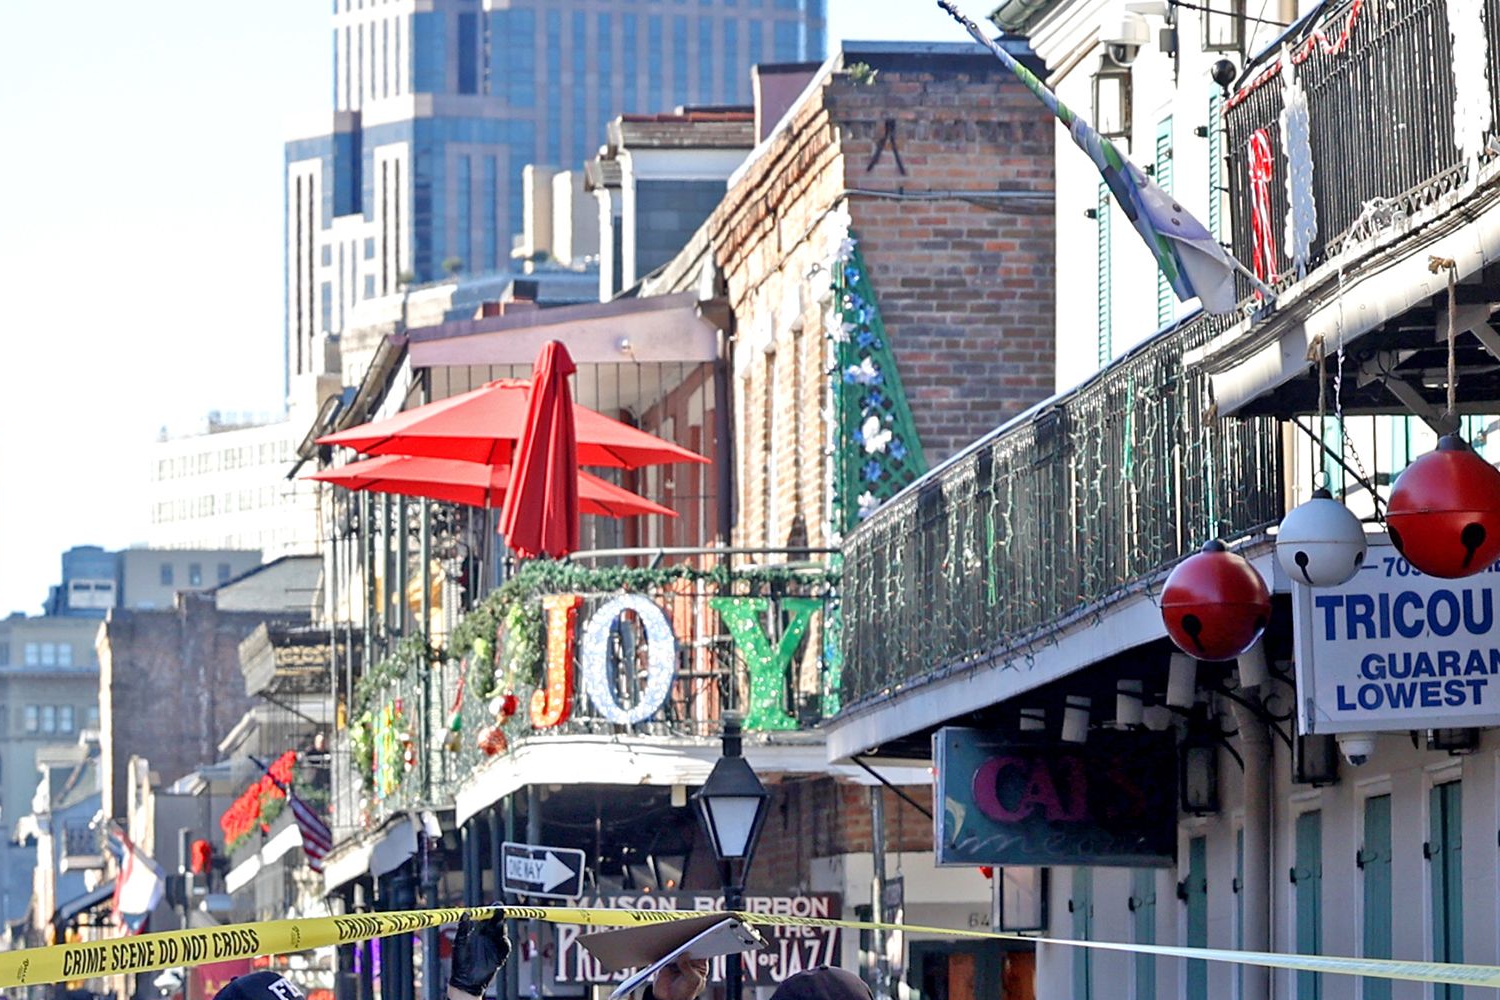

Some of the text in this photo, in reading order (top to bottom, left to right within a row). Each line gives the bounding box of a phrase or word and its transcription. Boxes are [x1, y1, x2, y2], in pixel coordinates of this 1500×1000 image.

[1315, 588, 1493, 641] TRICOU
[530, 593, 824, 731] JOY
[1336, 679, 1489, 711] LOWEST
[334, 915, 383, 941] CRIME
[387, 911, 436, 932] SCENE
[63, 946, 108, 977] CRIME
[111, 940, 156, 972] SCENE
[159, 937, 179, 965] DO
[182, 935, 209, 963] NOT
[214, 929, 260, 959] CROSS
[758, 953, 778, 966] OF
